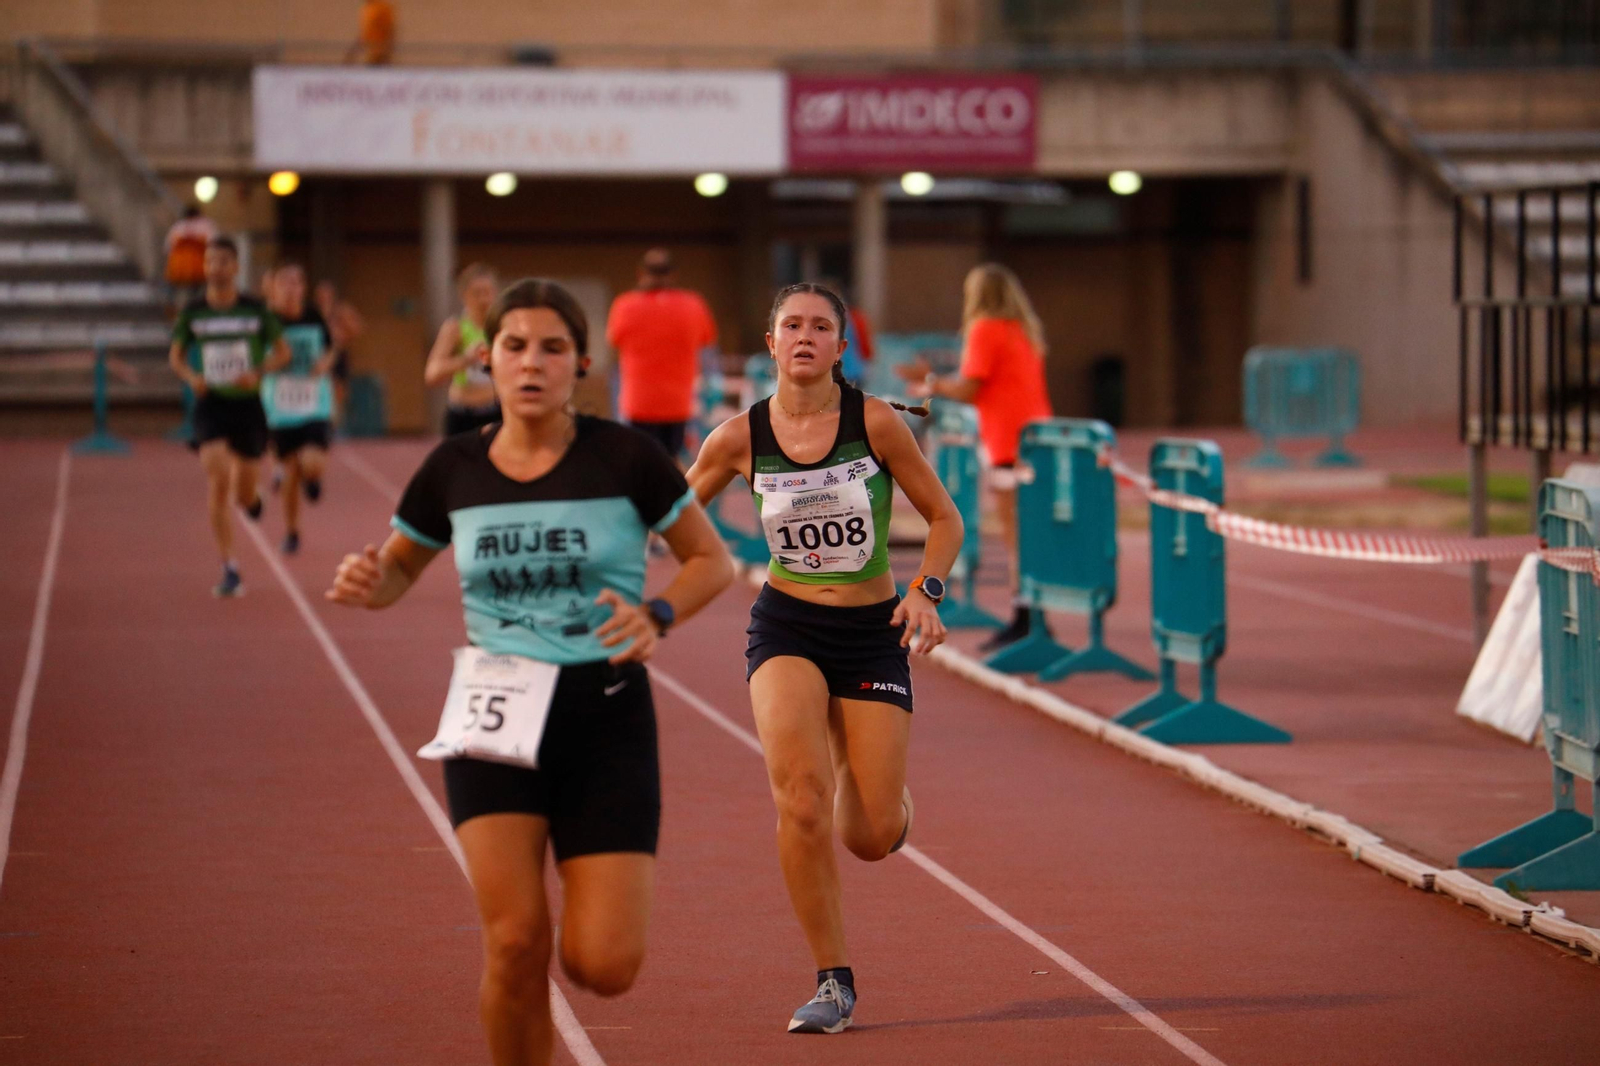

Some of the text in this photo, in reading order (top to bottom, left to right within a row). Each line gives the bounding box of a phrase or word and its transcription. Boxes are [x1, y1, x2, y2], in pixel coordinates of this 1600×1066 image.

[848, 87, 1030, 135] IMDECO
[777, 516, 867, 550] 1008
[872, 682, 908, 695] PATRICK
